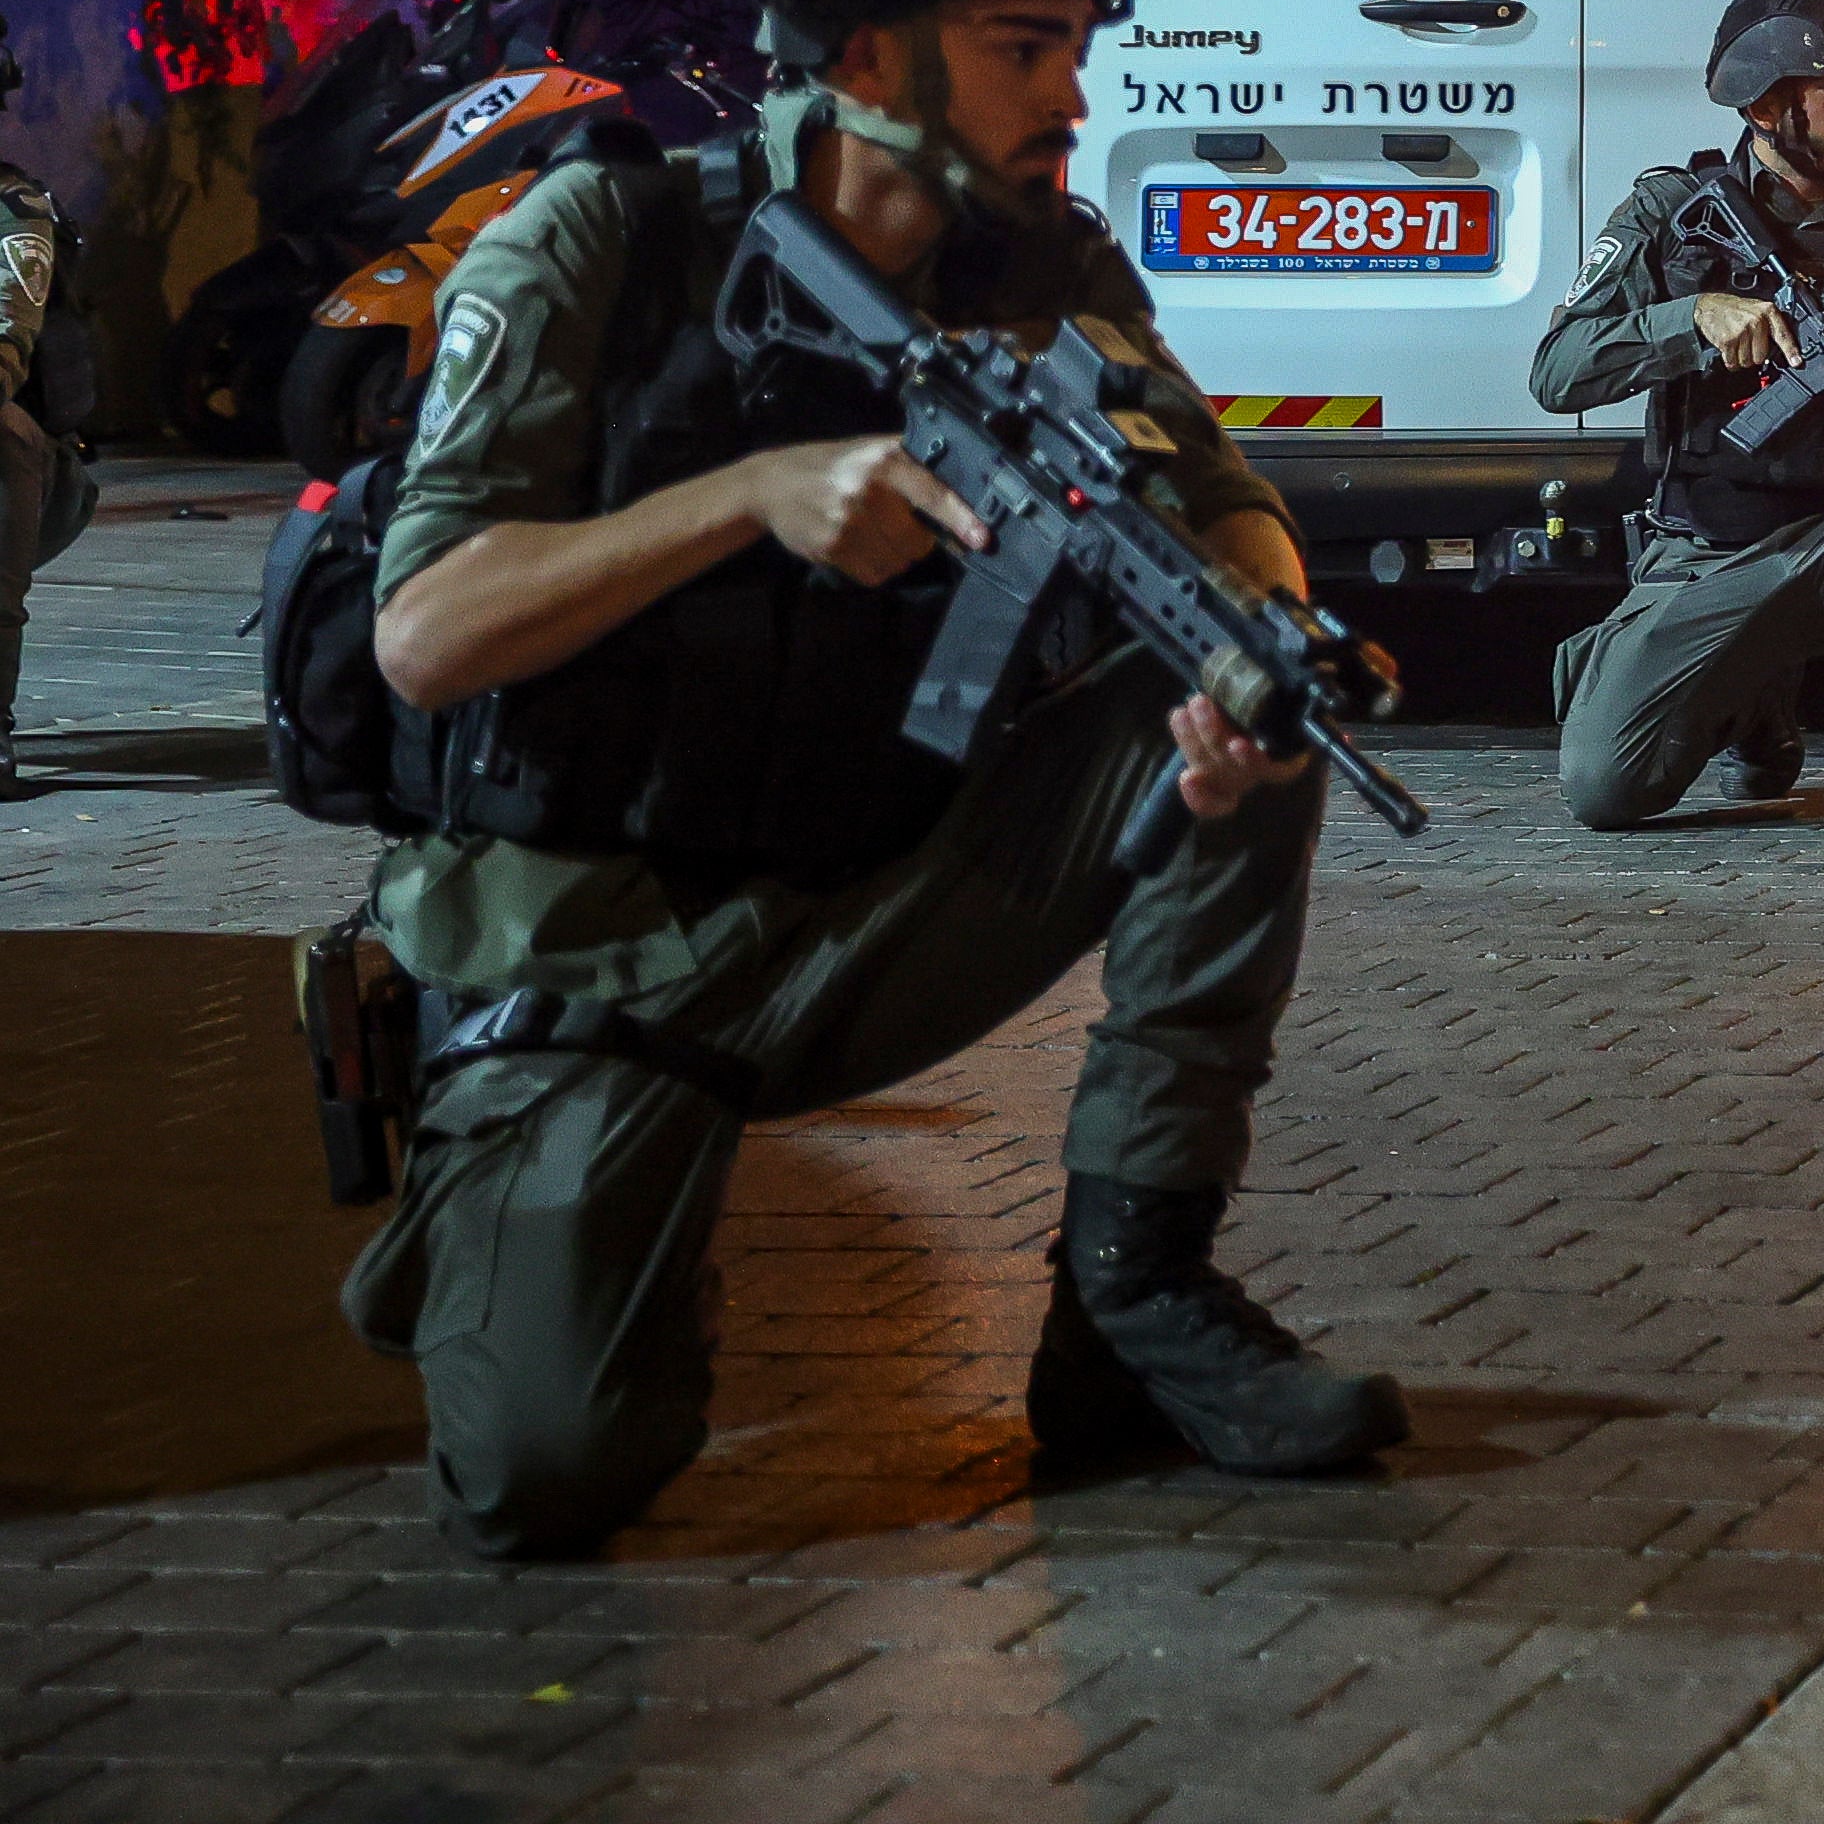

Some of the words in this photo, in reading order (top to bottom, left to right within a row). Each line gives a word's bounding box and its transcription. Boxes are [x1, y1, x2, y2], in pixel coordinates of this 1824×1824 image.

[1119, 24, 1262, 54] Jumpy
[1124, 74, 1285, 114] ישראל
[1322, 79, 1517, 114] משטרת
[1153, 209, 1173, 235] IL
[1278, 258, 1305, 268] 100
[1315, 256, 1361, 269] ישראל
[1368, 257, 1419, 269] משטרת
